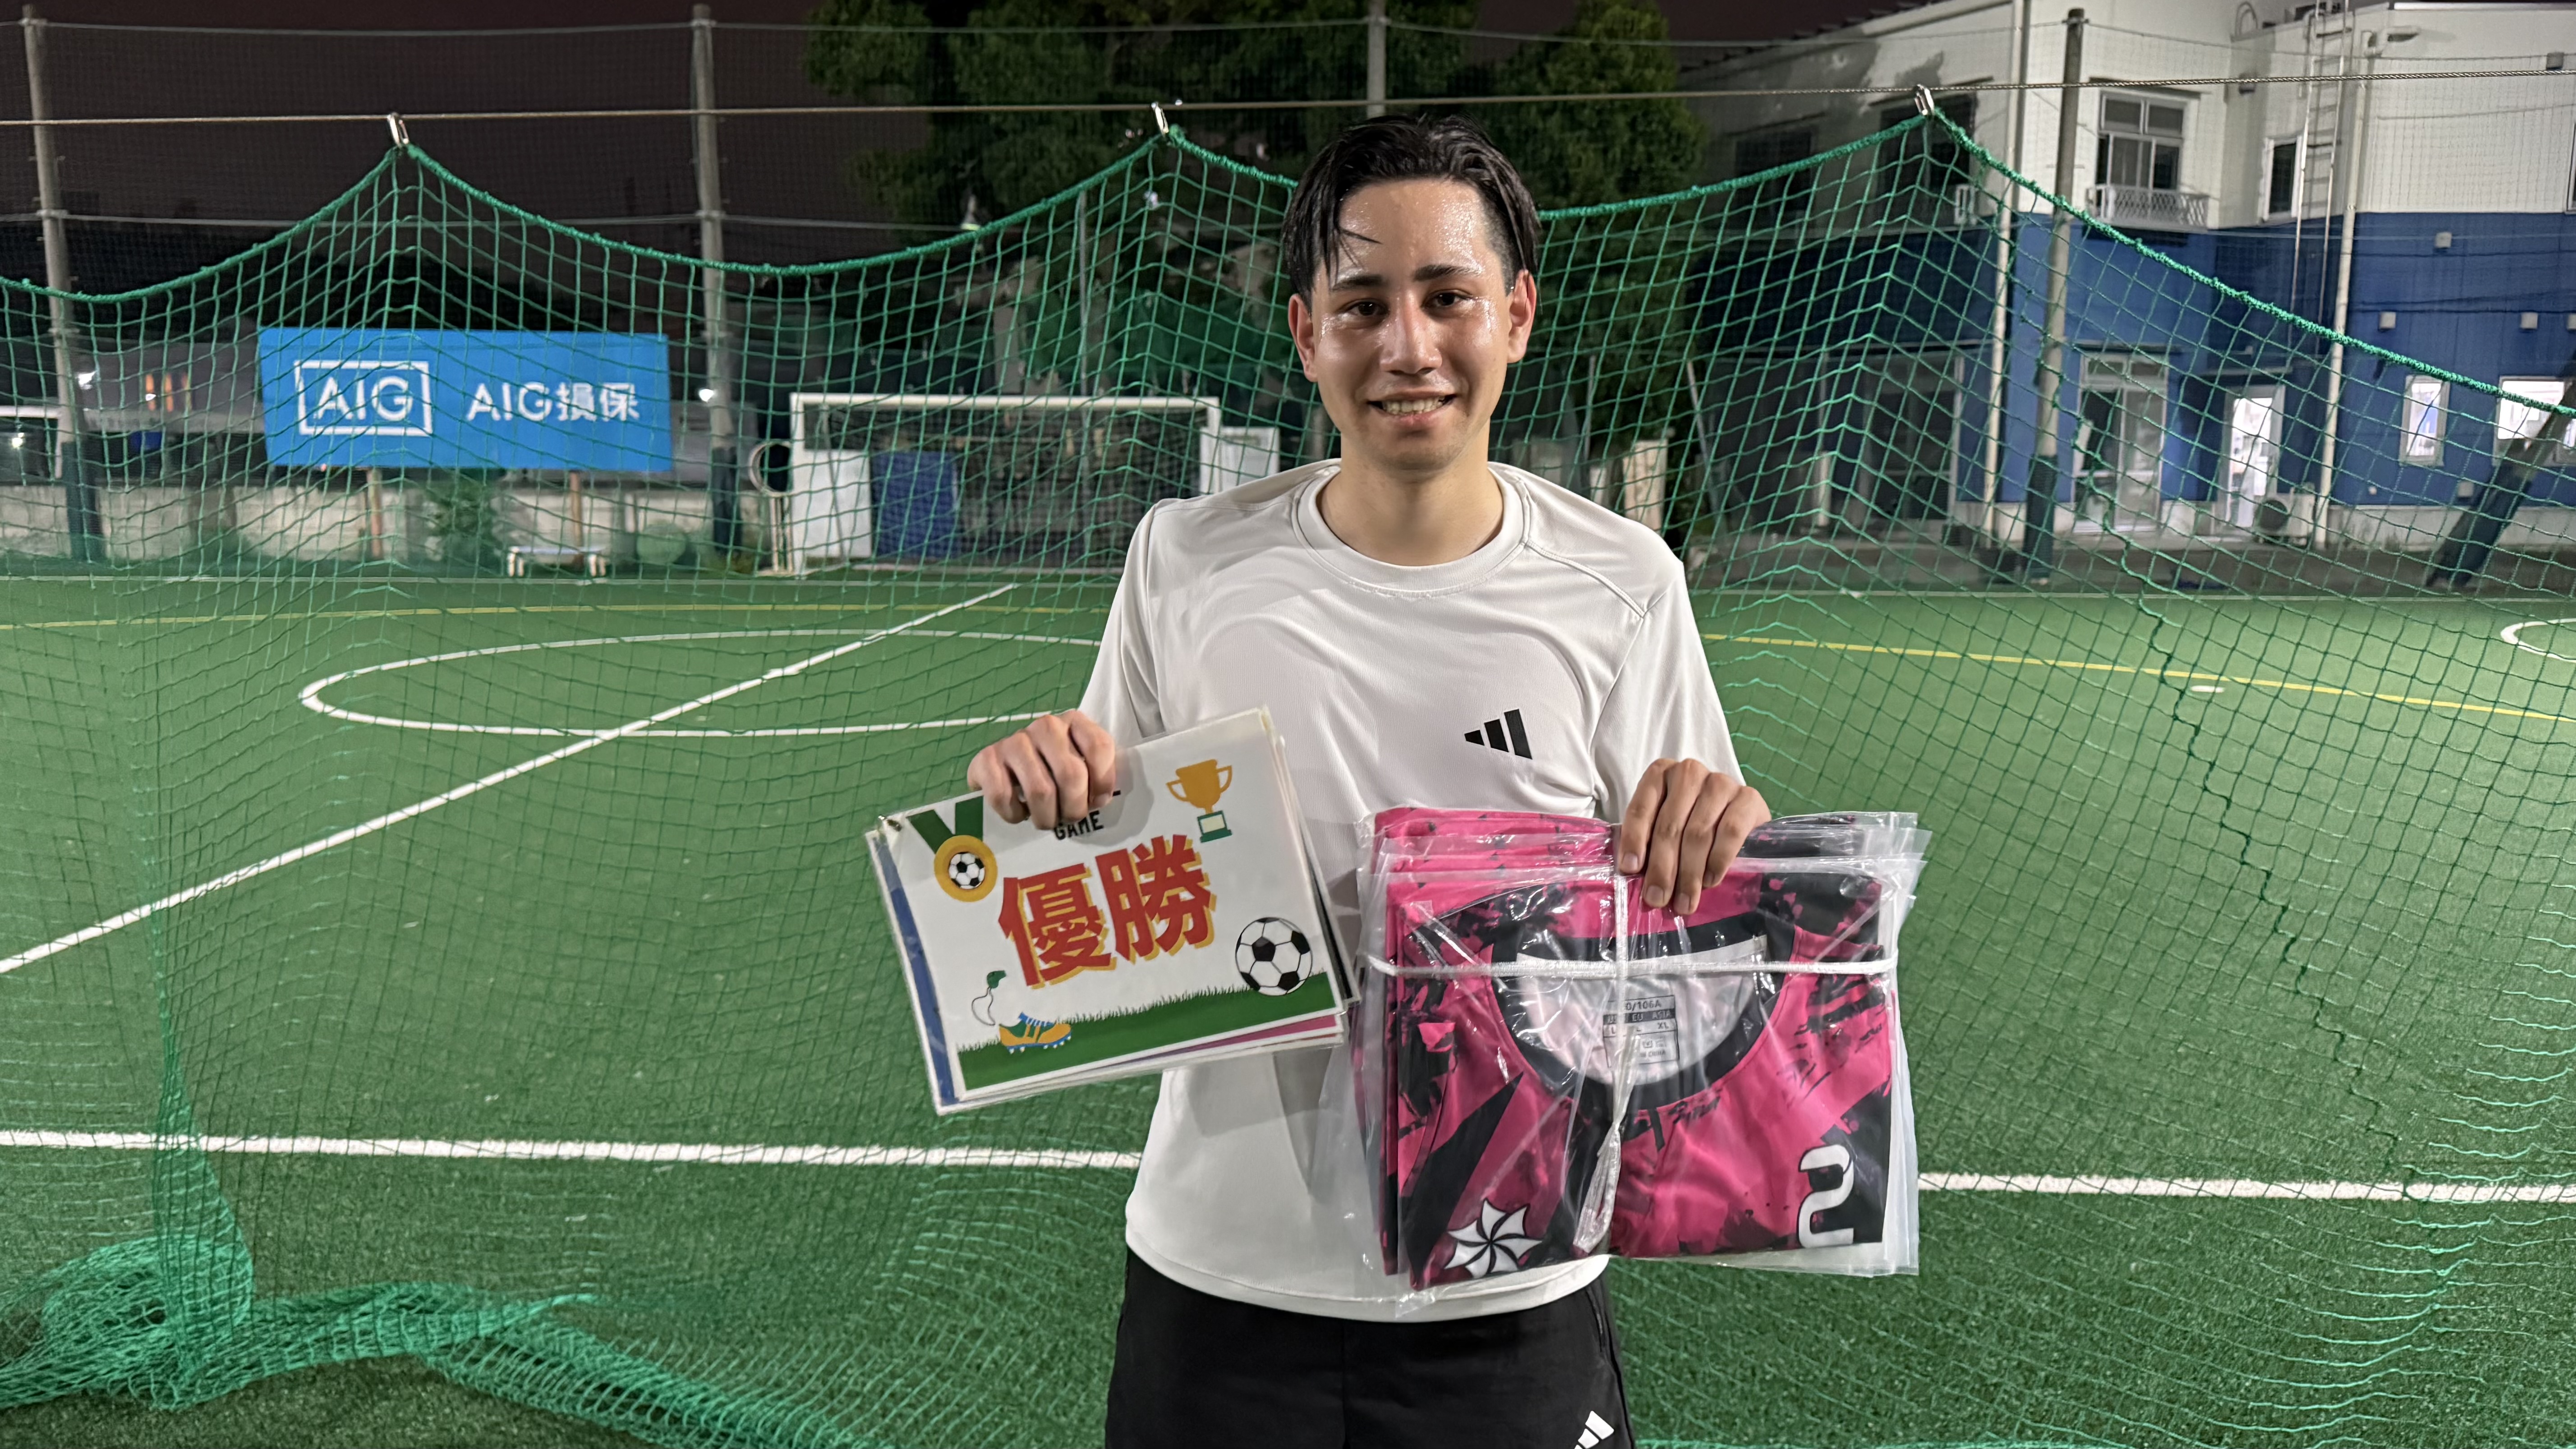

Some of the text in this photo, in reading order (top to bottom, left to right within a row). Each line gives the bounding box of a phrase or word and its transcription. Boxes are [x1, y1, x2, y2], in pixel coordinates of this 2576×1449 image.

[313, 376, 413, 421] AIG
[467, 382, 639, 421] AIG損保
[1054, 810, 1104, 840] GAME
[998, 834, 1216, 989] 優勝
[1799, 1144, 1854, 1248] 2
